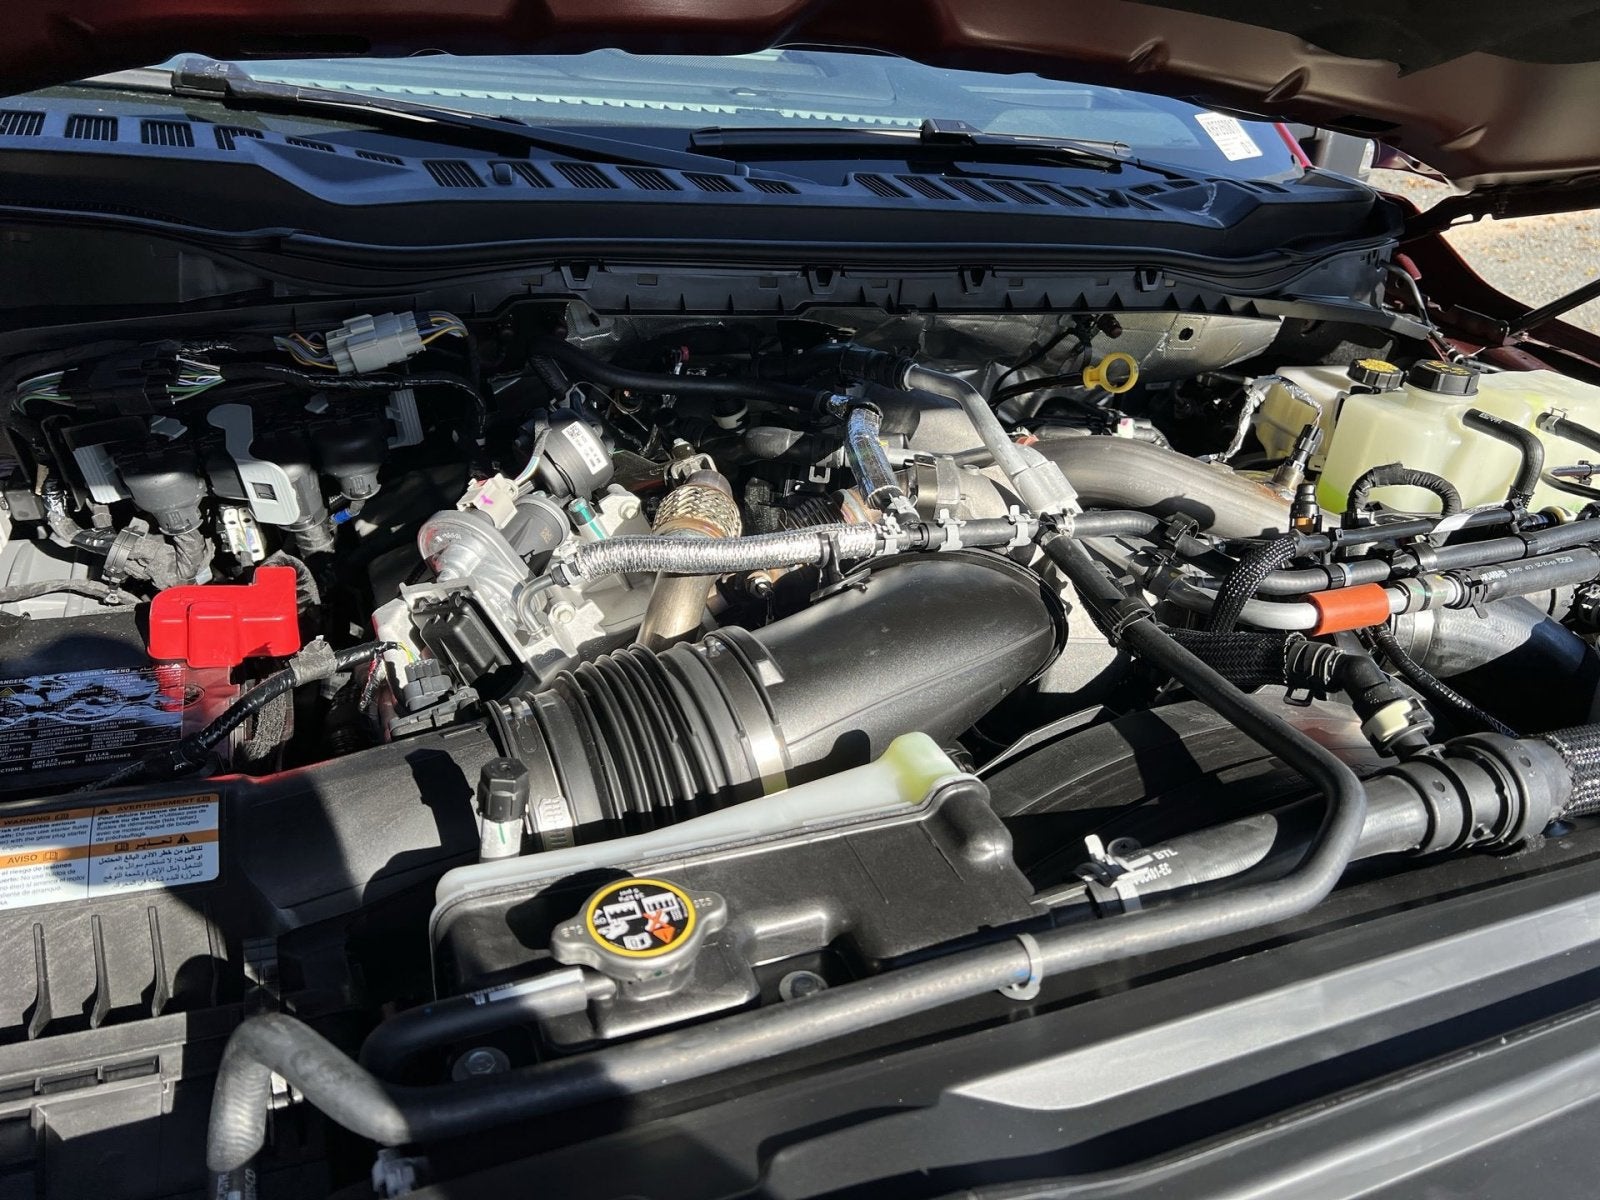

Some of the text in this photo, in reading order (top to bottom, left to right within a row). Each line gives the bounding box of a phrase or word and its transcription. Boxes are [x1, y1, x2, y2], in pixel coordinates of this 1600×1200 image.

[4, 815, 50, 826] WARNING
[7, 854, 38, 864] AVISO
[1152, 848, 1178, 860] BTL
